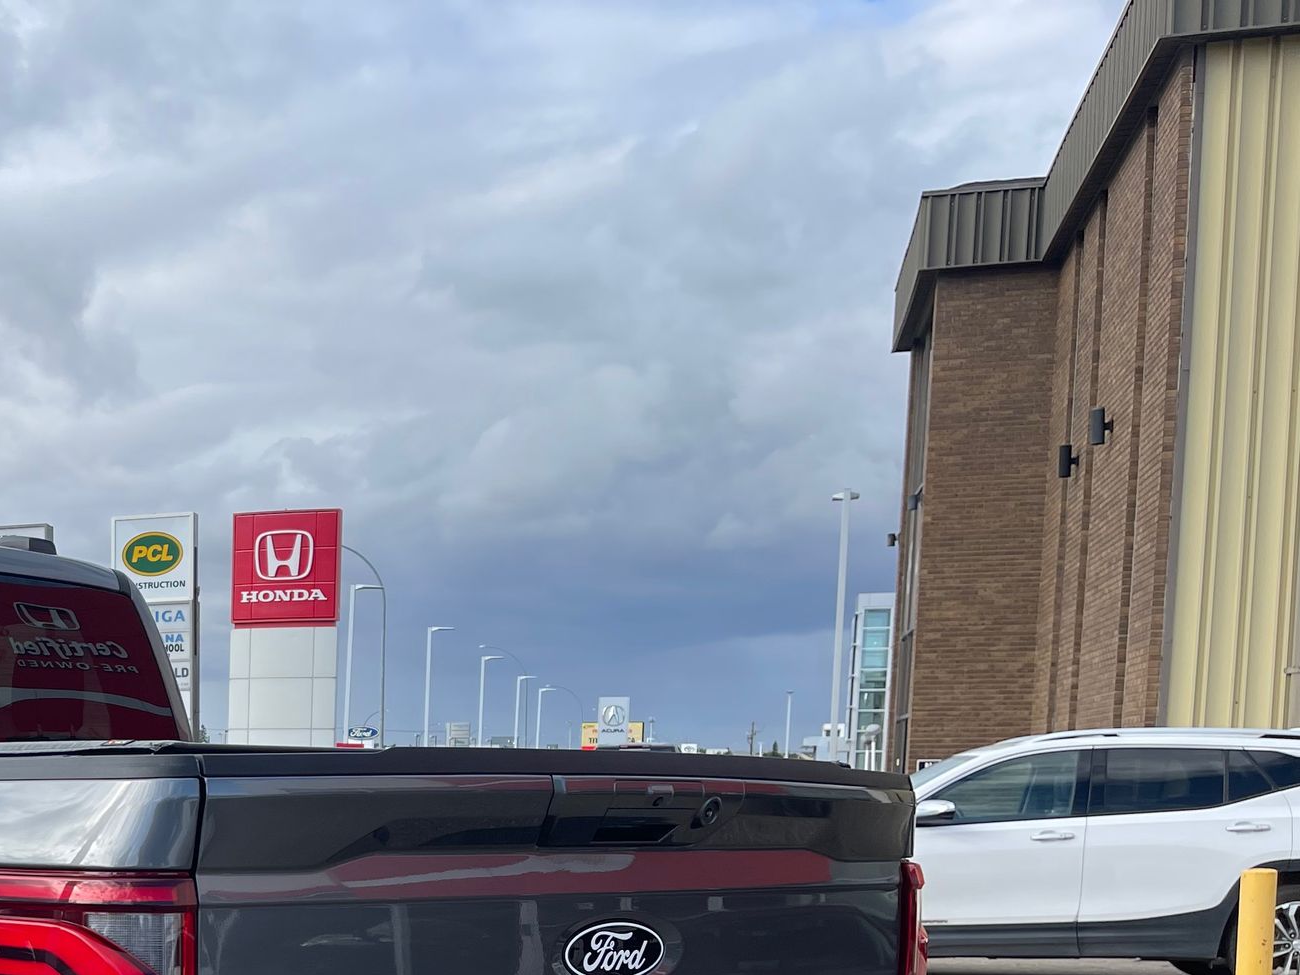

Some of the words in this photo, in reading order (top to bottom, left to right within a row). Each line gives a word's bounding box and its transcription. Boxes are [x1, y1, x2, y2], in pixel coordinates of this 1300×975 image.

[131, 544, 174, 563] PCL
[240, 588, 328, 603] HONDA
[350, 728, 373, 738] Ford
[582, 930, 649, 973] Ford
